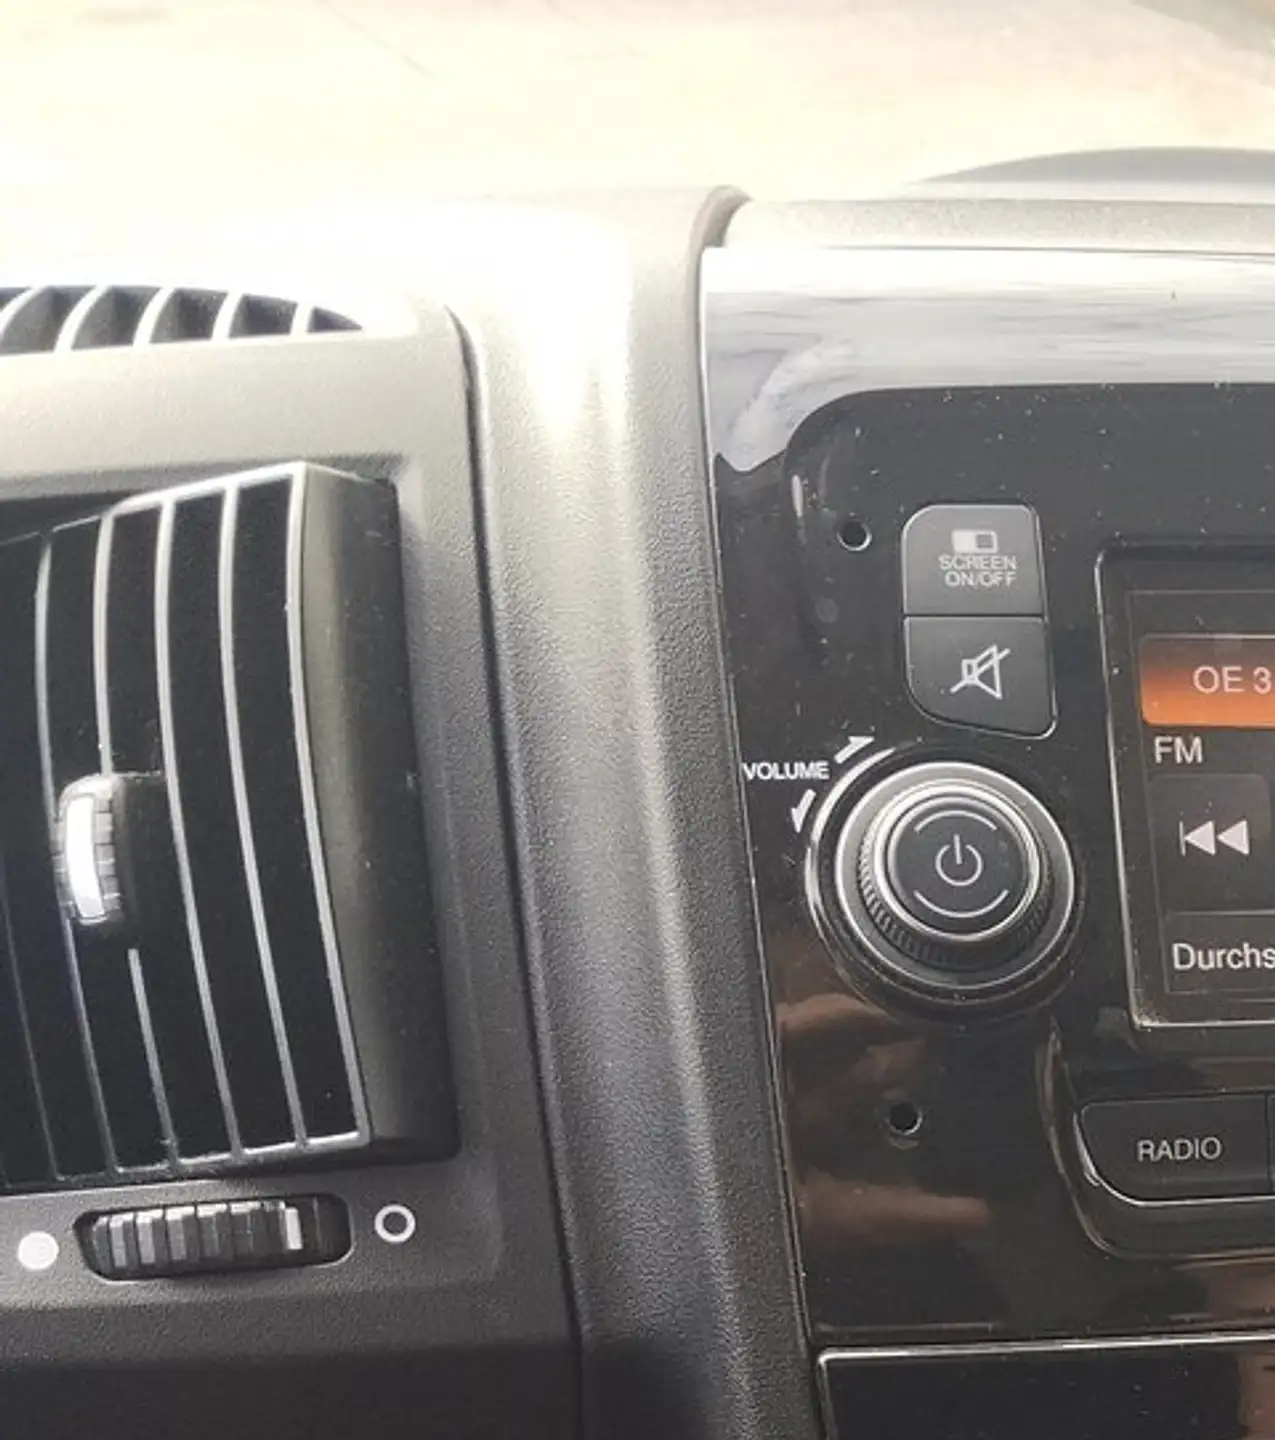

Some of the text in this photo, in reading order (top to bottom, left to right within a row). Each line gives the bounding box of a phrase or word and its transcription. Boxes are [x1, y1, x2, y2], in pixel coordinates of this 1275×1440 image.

[938, 554, 1018, 572] SCREEN
[944, 571, 1017, 588] ON/OFF
[1193, 666, 1273, 694] OE 3
[1154, 736, 1203, 765] FM
[742, 761, 830, 781] VOLUME
[1136, 1137, 1223, 1162] RADIO
